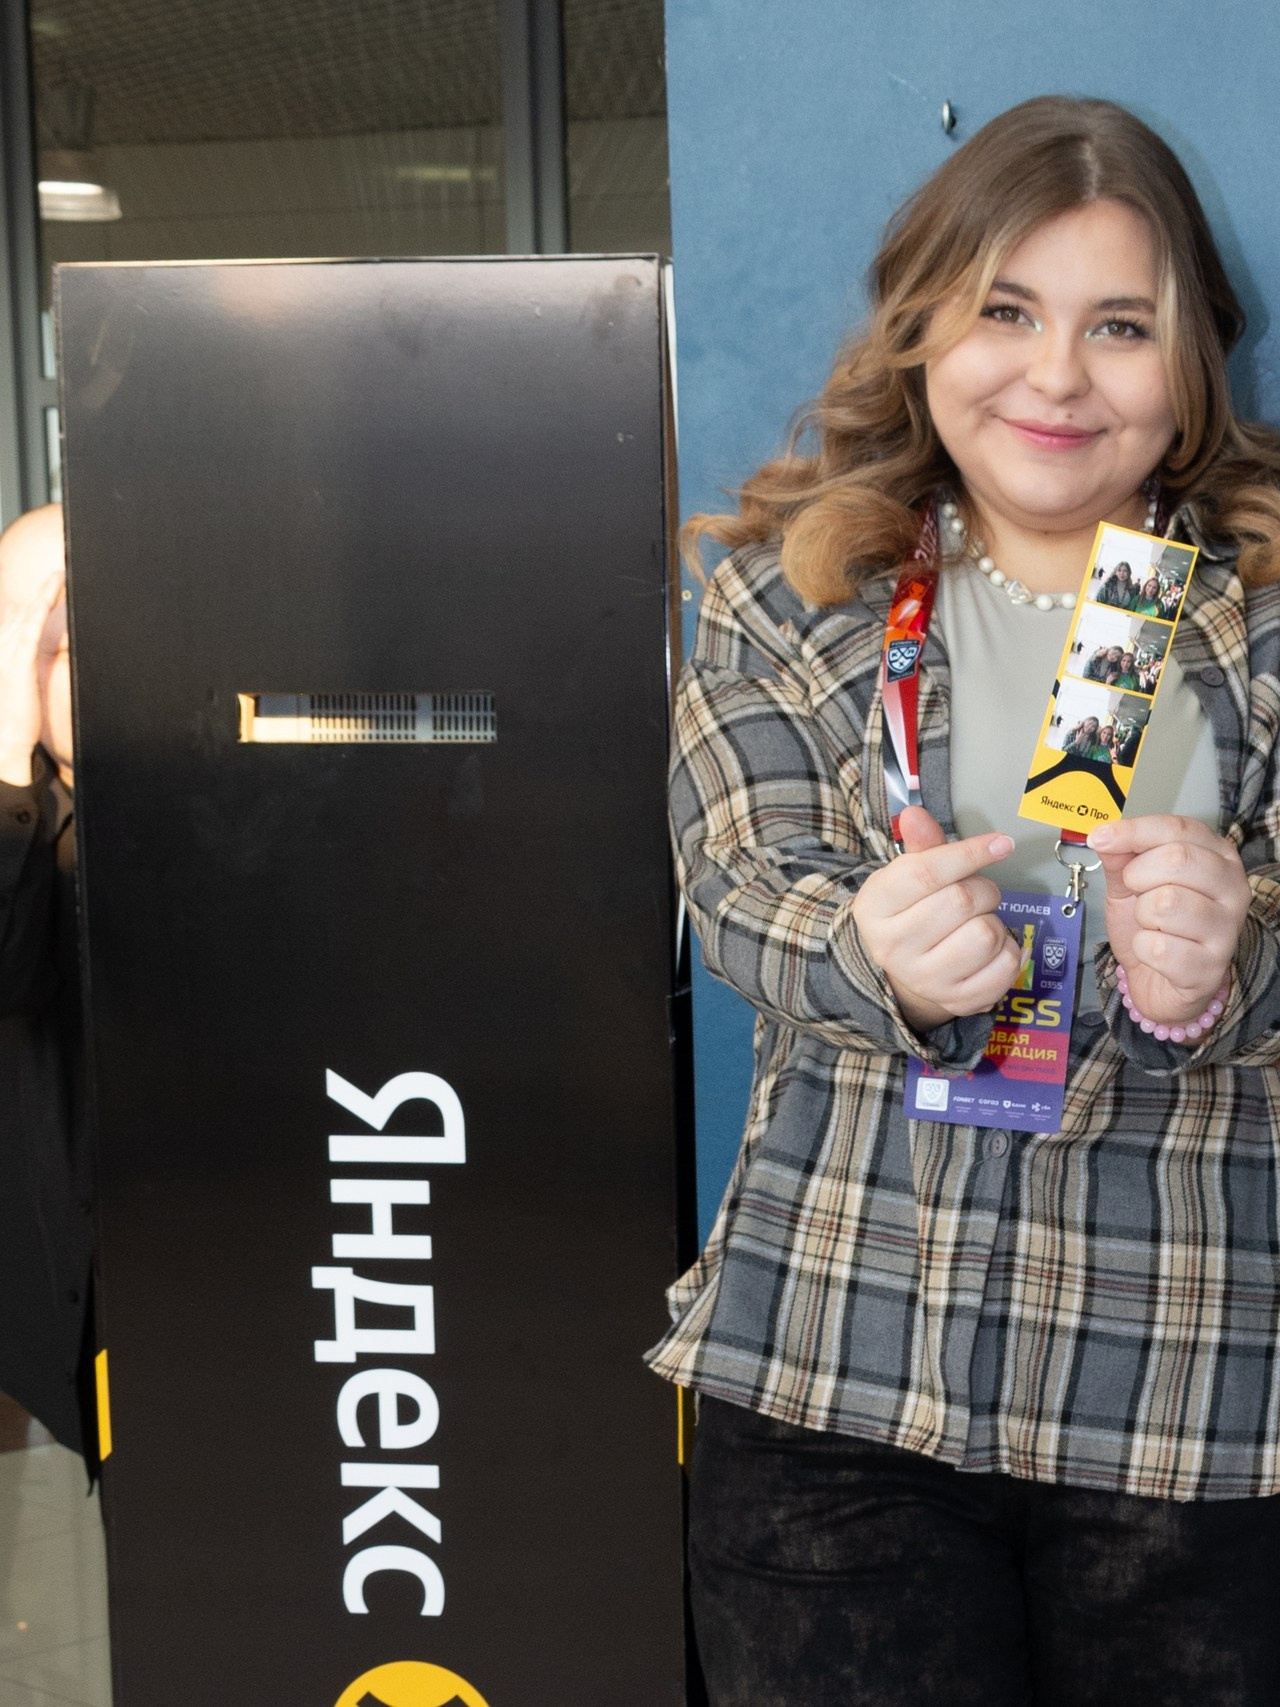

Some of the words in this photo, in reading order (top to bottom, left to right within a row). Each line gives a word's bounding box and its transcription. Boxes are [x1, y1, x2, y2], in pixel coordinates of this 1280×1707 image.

[1040, 795, 1075, 813] Яндекс
[1090, 808, 1110, 821] Про
[1010, 903, 1051, 915] ЮЛАЕВ
[1040, 980, 1063, 990] 0355
[311, 1067, 467, 1617] Яндекс
